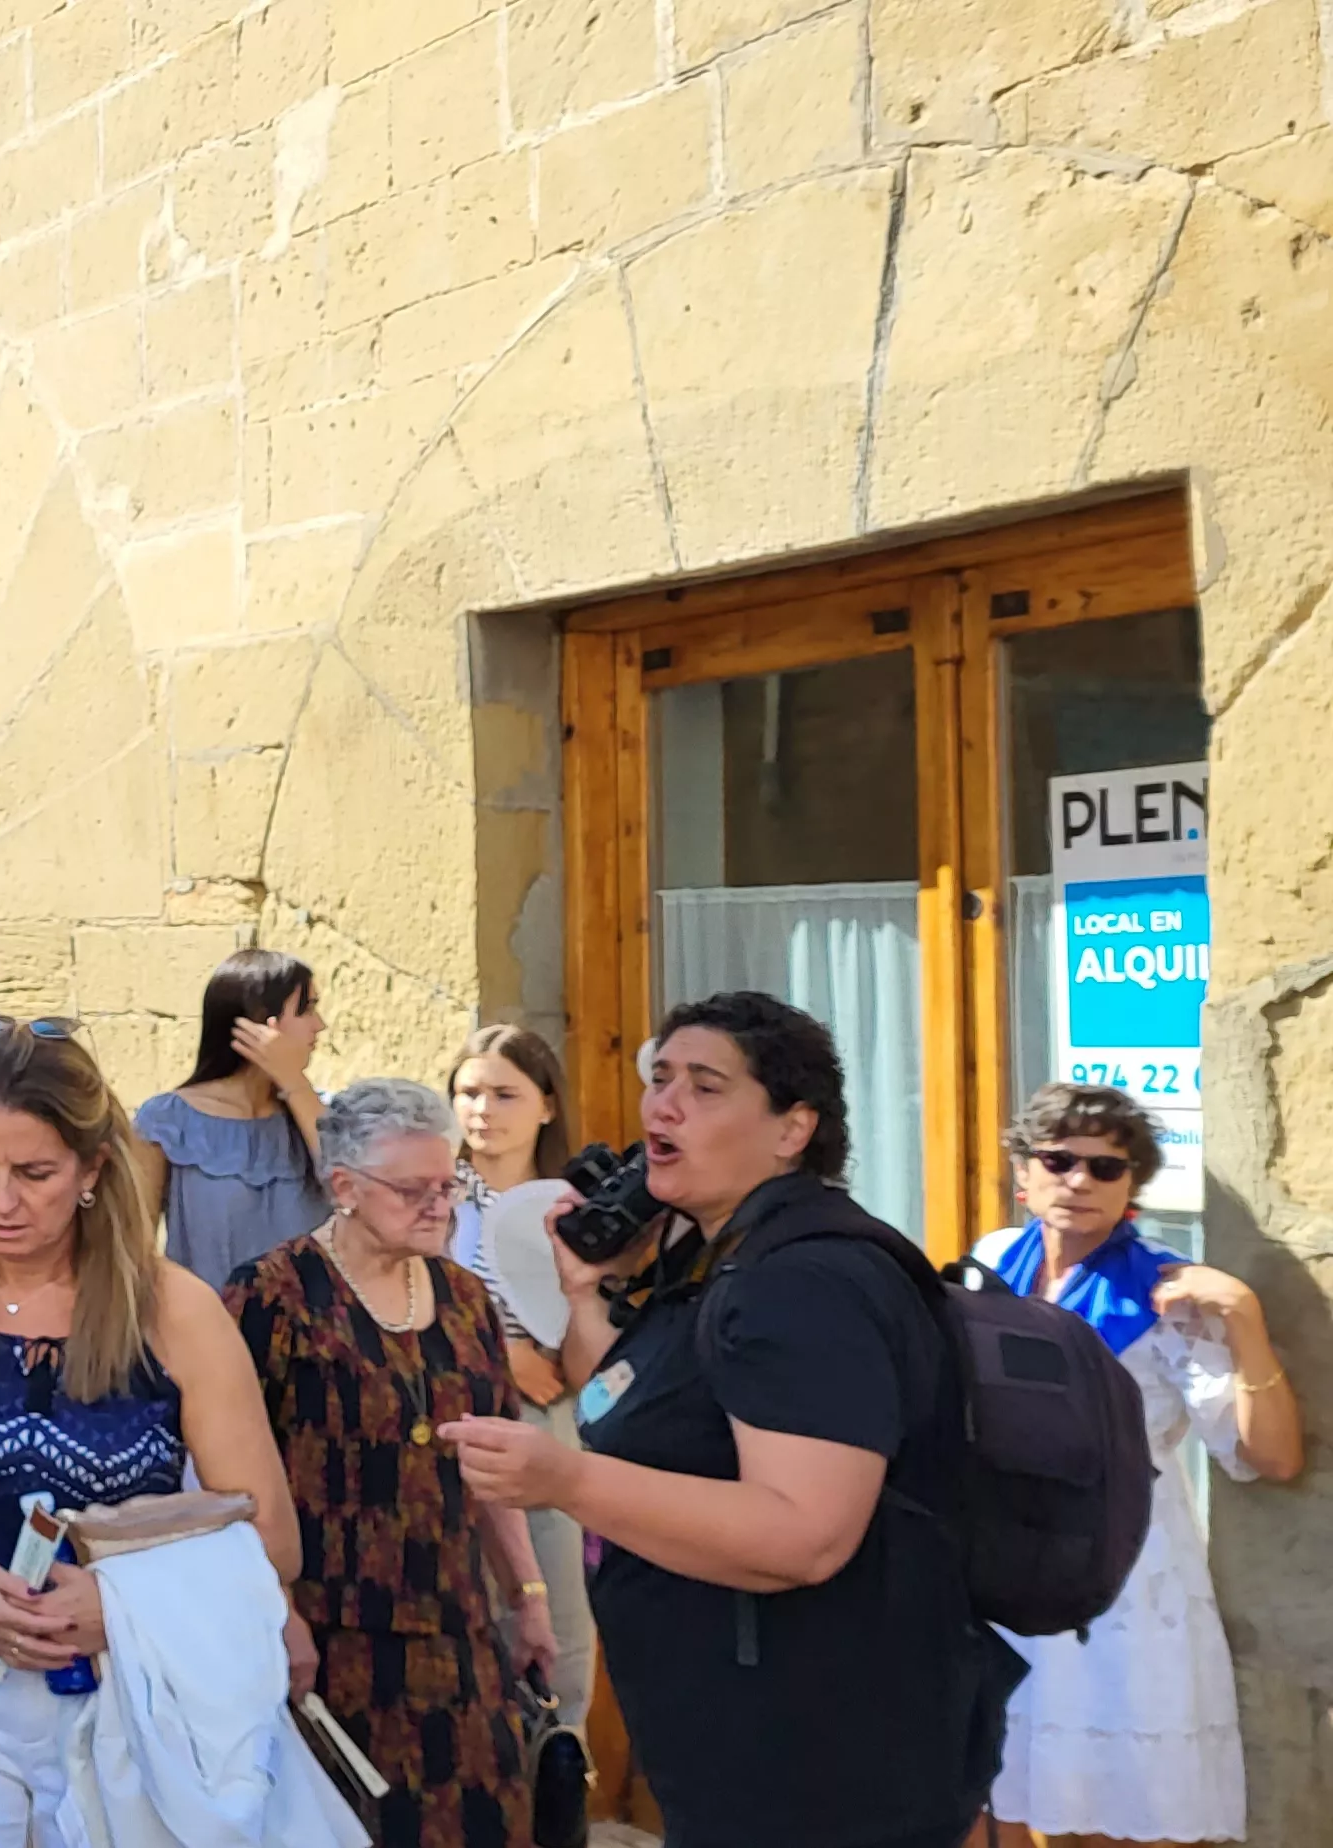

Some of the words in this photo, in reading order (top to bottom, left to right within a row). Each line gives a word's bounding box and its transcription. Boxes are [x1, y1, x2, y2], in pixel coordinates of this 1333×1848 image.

[1073, 911, 1146, 936] LOCAL
[1149, 909, 1183, 933] EN
[1071, 1063, 1129, 1088] 974
[1141, 1064, 1181, 1094] 22
